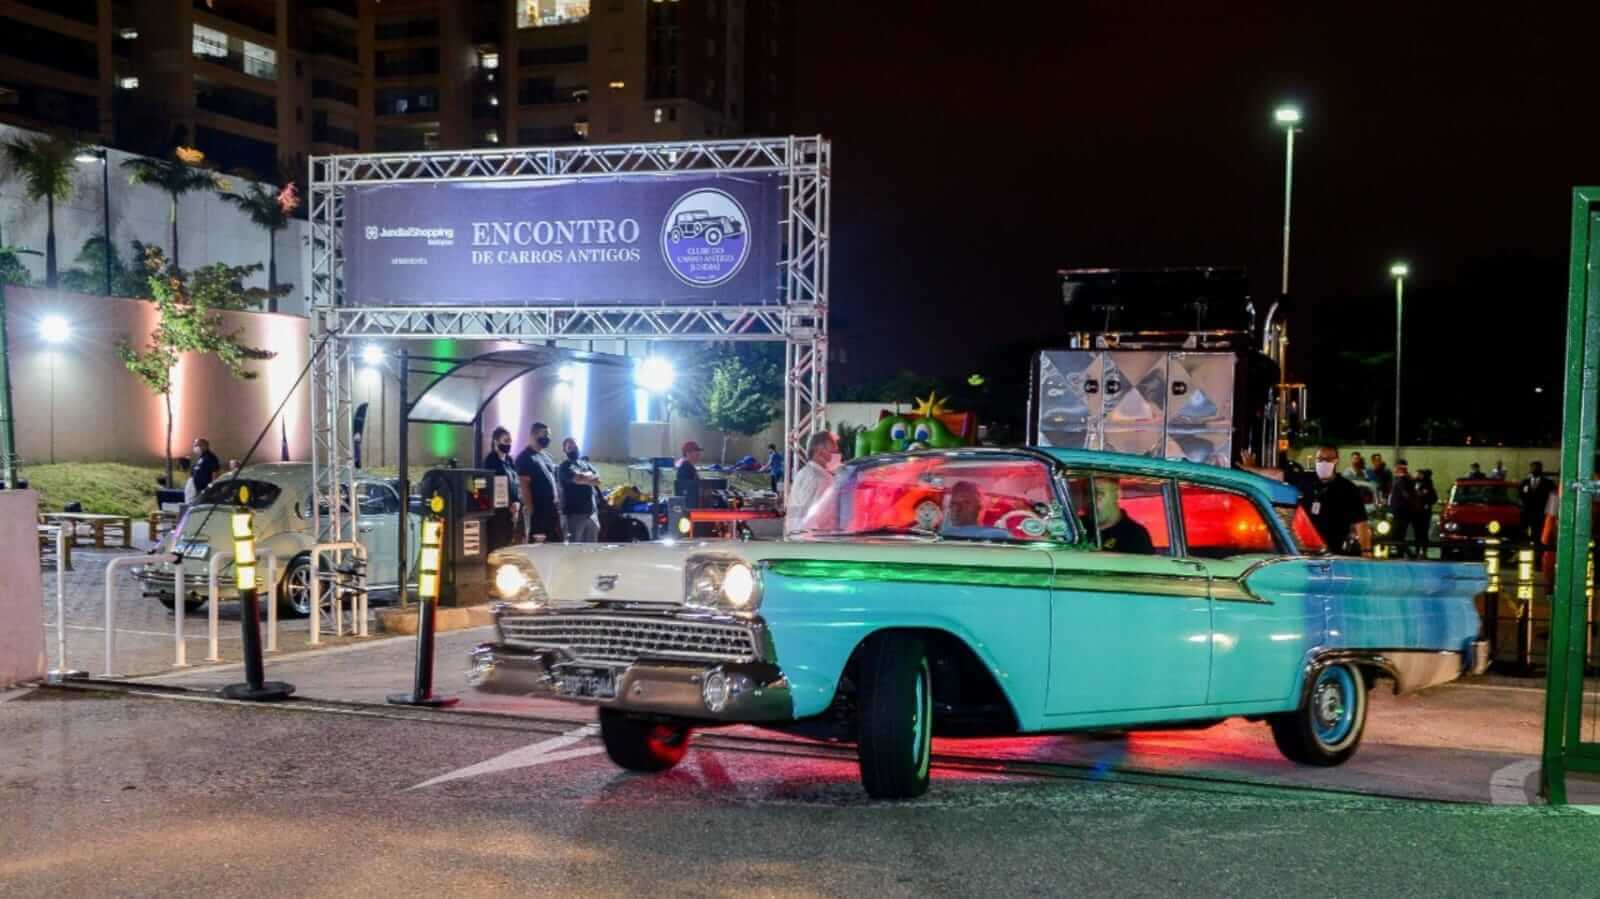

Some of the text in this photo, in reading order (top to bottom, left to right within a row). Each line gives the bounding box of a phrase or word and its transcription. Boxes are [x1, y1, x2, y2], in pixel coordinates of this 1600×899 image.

[471, 217, 641, 247] ENCONTRO
[471, 248, 641, 265] DE CARROS ANTIGOS
